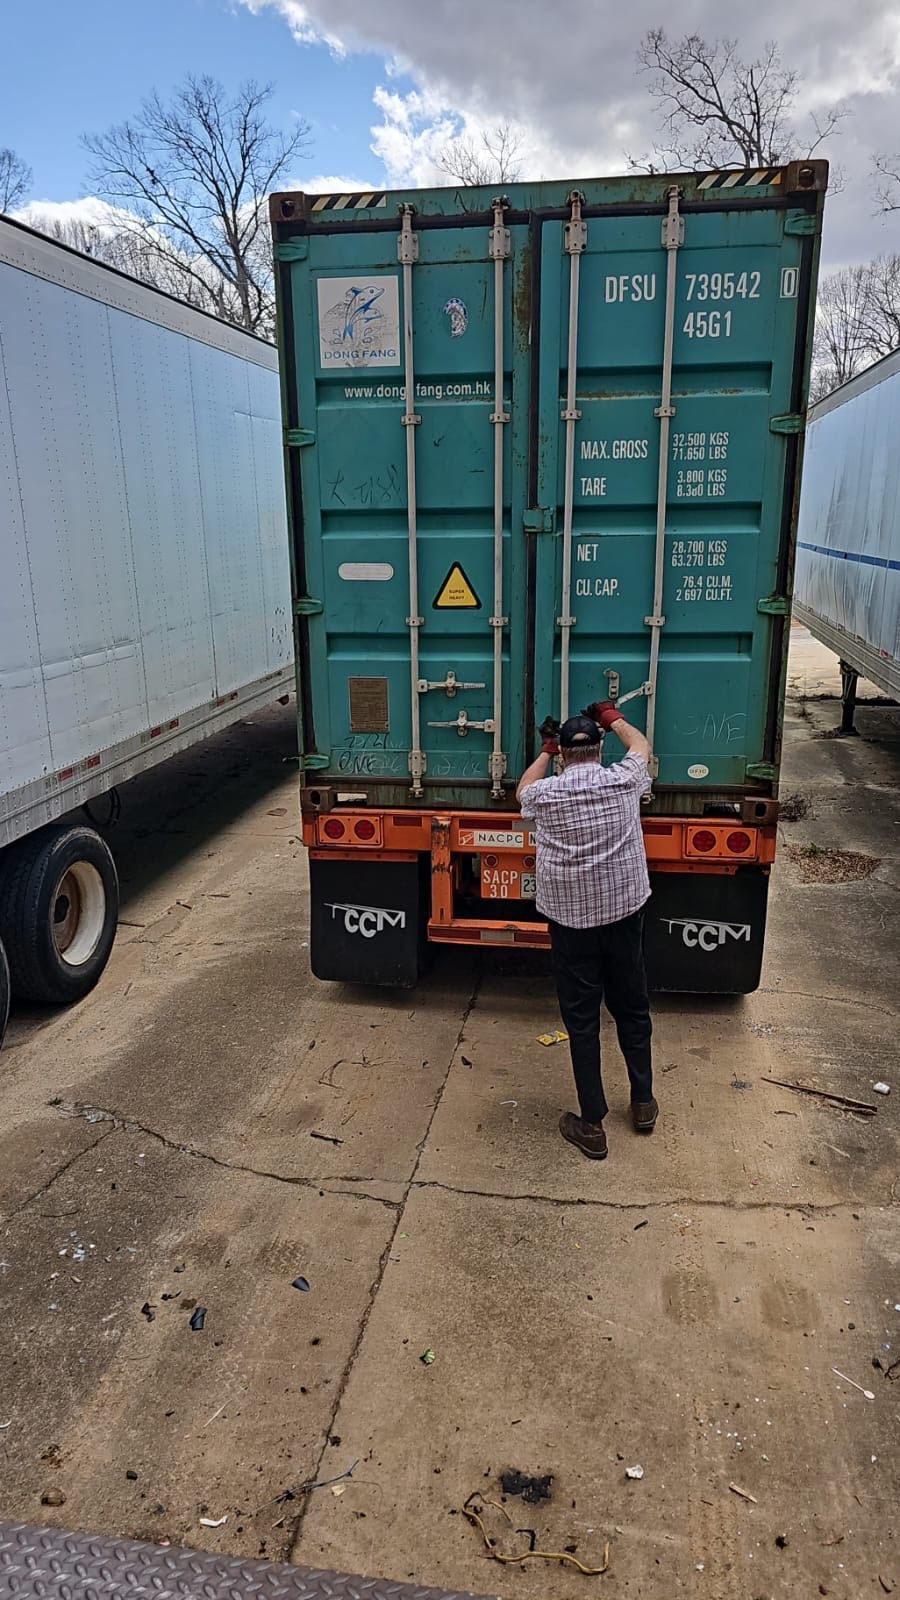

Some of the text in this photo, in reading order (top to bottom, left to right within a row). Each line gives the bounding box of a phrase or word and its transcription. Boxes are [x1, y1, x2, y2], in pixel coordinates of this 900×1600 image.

[605, 268, 797, 303] DFSU 739542 0
[683, 310, 733, 338] 45G1
[324, 349, 396, 360] DONG FANG
[672, 432, 729, 447] 32.500 KGS
[581, 440, 648, 460] MAX. GROSS
[672, 446, 727, 461] 71.650 LBS
[677, 469, 727, 483] 3.800 KGS
[580, 477, 607, 496] TARE
[707, 483, 725, 496] LBS
[577, 543, 598, 562] NET
[672, 540, 727, 553] 28.700 KGS
[671, 553, 725, 567] 63.270 LBS
[594, 578, 620, 597] CAP.
[682, 576, 703, 588] 76.4
[478, 833, 523, 844] NACPC
[483, 869, 518, 884] SACP
[489, 884, 508, 898] 30
[344, 909, 406, 938] CCM
[682, 923, 751, 951] CCM
